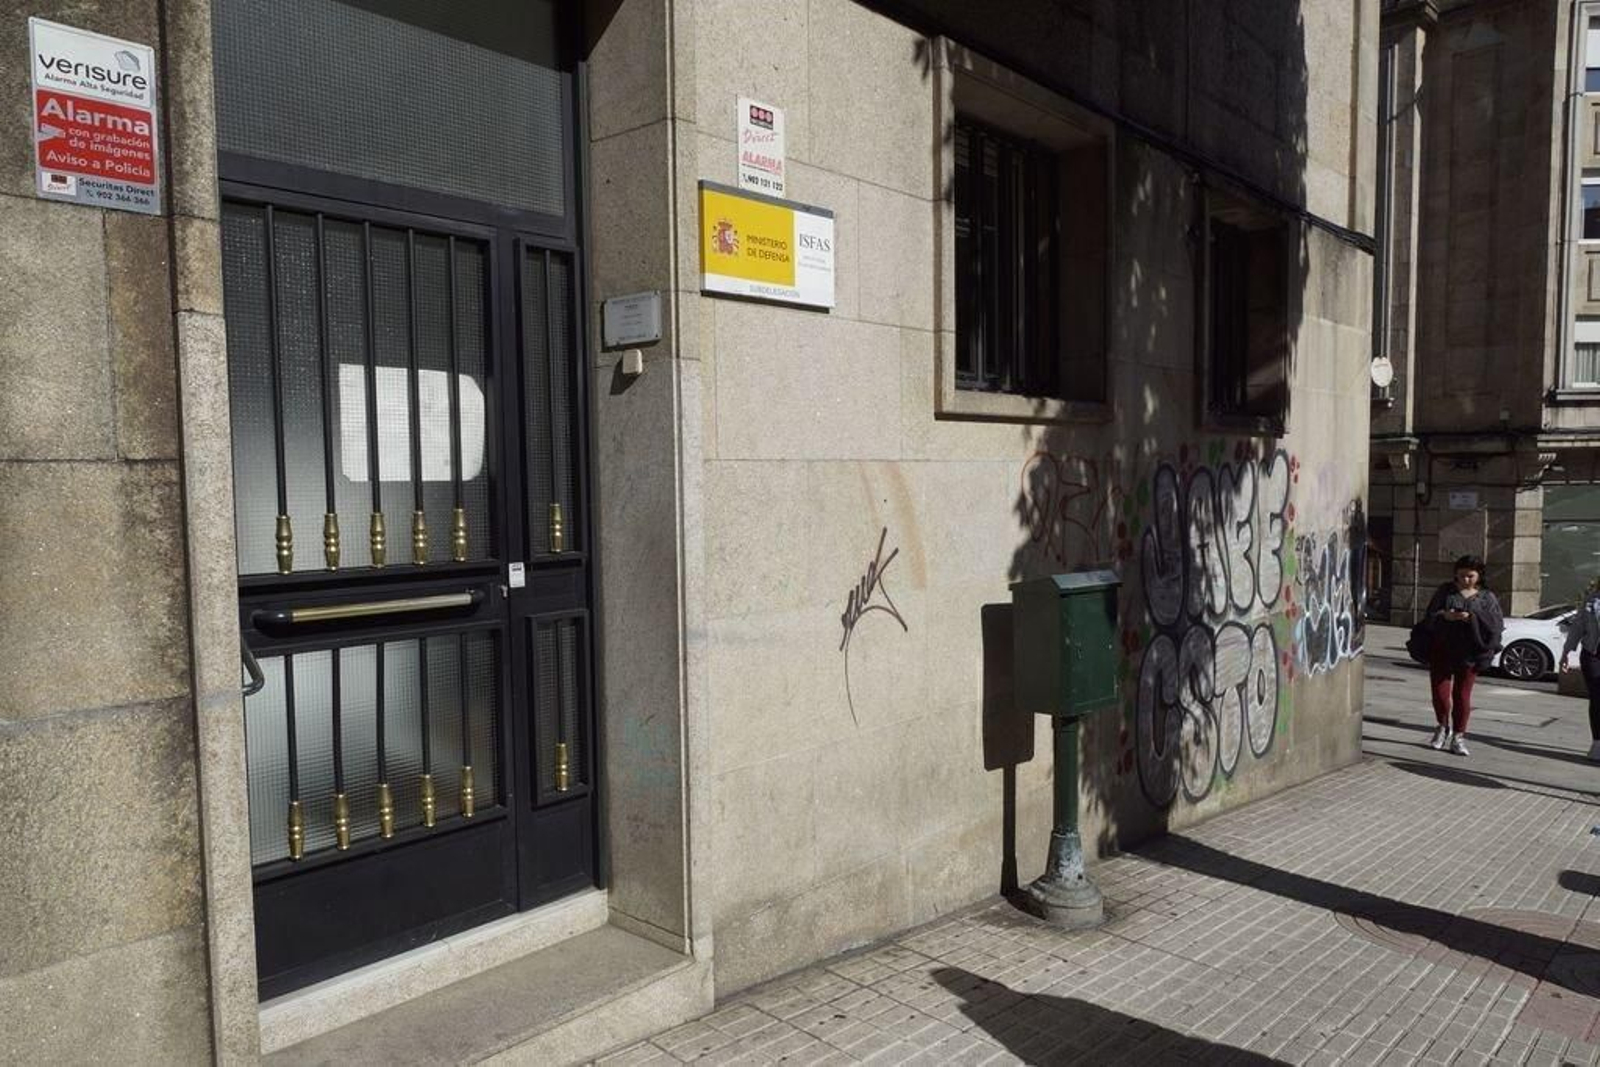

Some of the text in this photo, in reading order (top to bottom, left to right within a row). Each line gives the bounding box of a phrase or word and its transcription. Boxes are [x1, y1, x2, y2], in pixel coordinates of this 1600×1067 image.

[39, 53, 148, 90] verisure
[45, 72, 145, 100] Alarma Alta Seguridad
[41, 98, 150, 136] Alarma
[69, 127, 151, 149] con grabación
[46, 149, 88, 167] Aviso
[92, 160, 100, 169] a
[69, 138, 151, 160] de imágenes
[743, 150, 782, 173] ALARMA
[79, 177, 155, 197] Securitas Direct
[96, 191, 113, 200] 902
[746, 234, 788, 251] MINISTERIO
[799, 233, 831, 252] ISFAS
[747, 247, 757, 257] DE
[758, 249, 790, 263] DEFENSA
